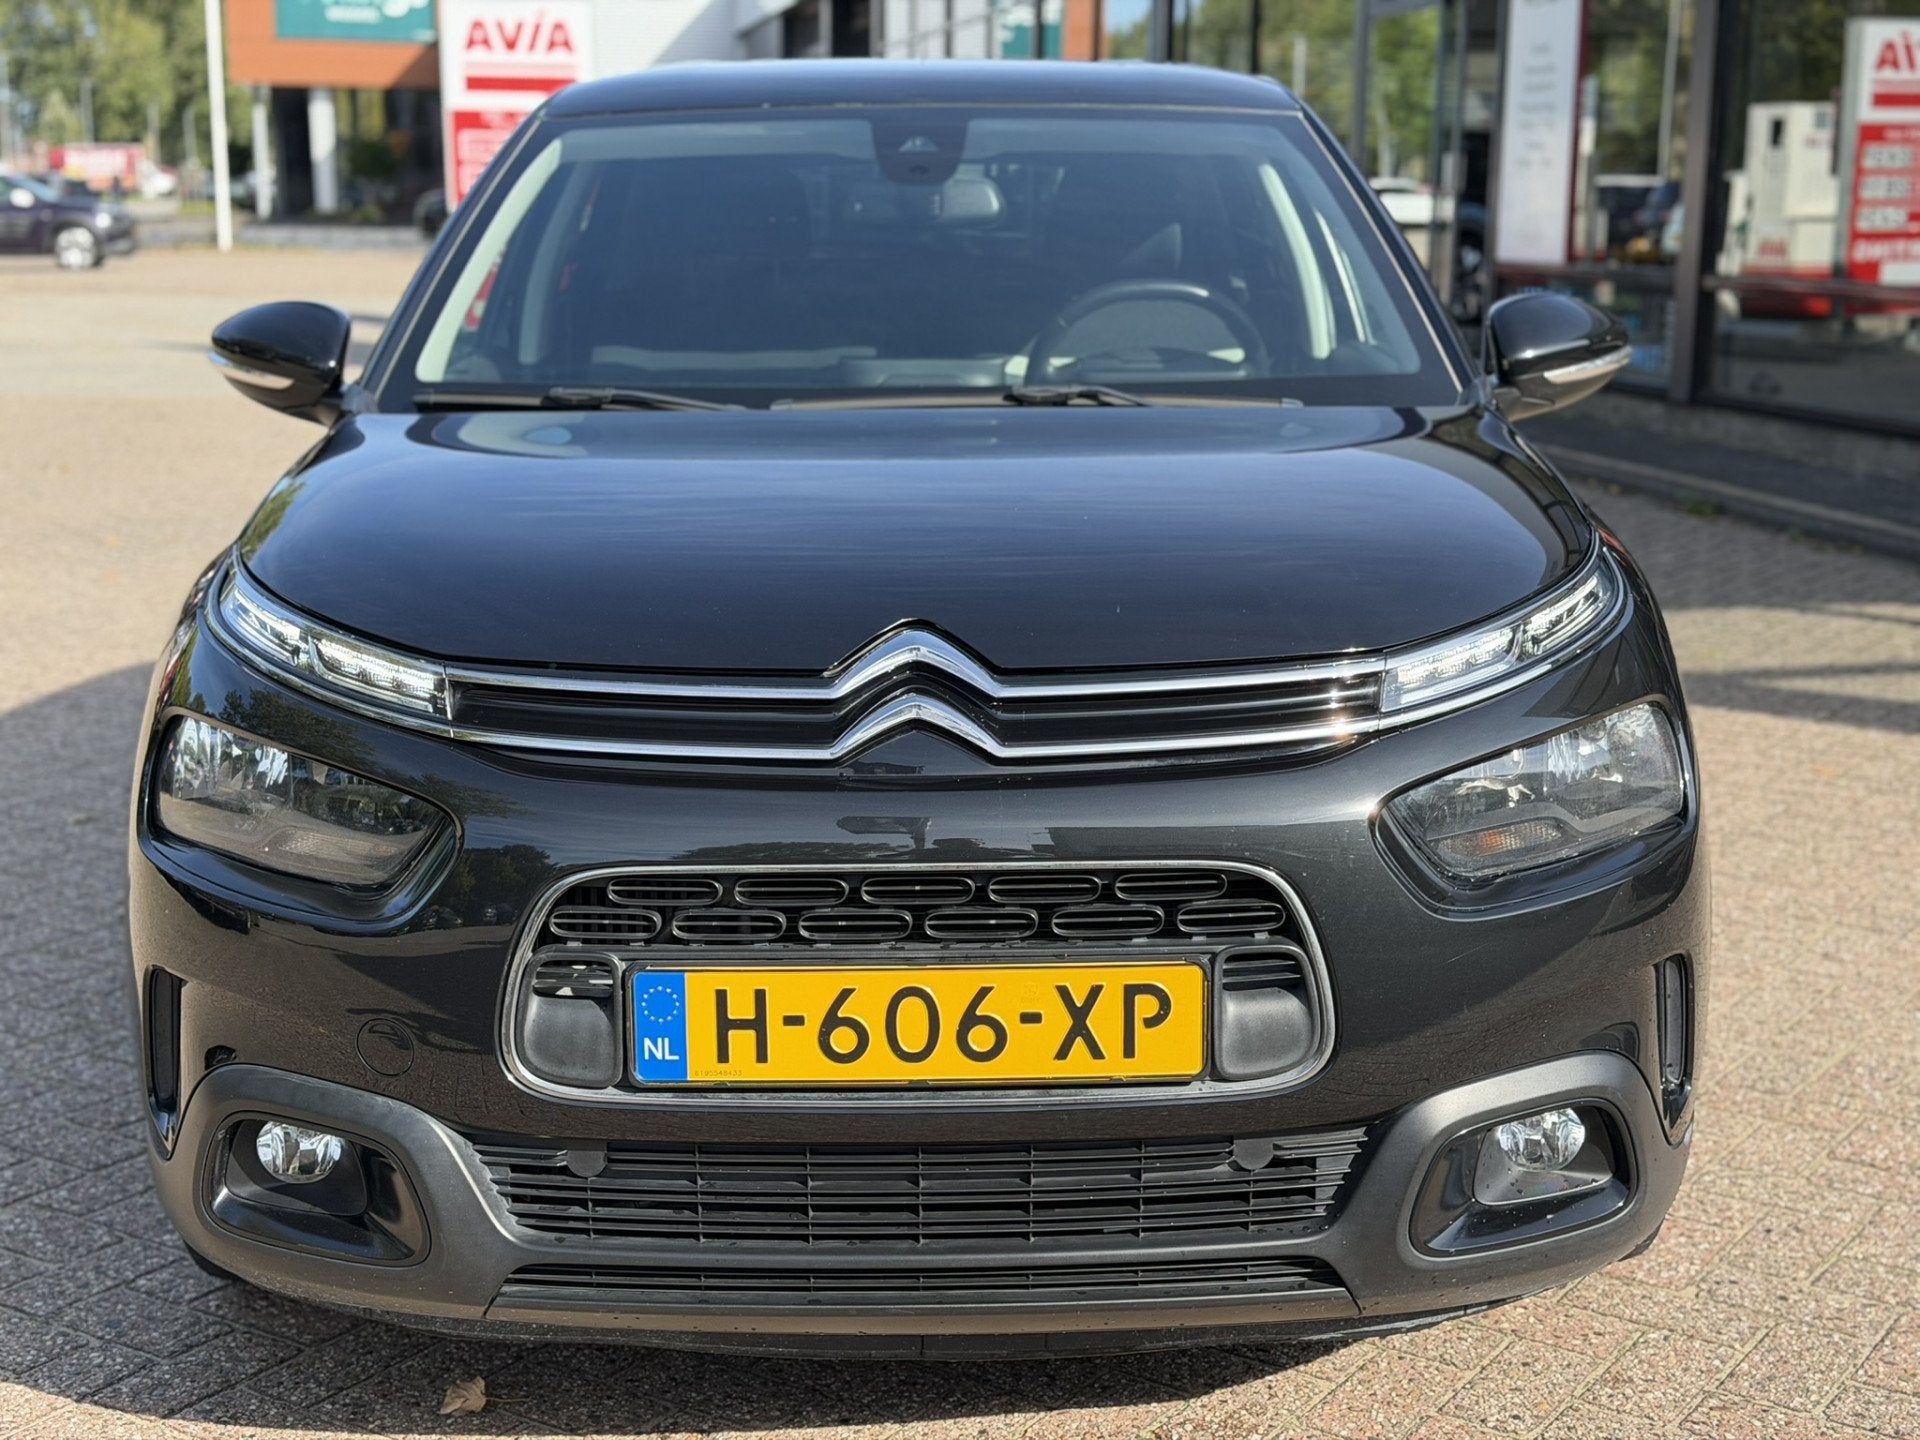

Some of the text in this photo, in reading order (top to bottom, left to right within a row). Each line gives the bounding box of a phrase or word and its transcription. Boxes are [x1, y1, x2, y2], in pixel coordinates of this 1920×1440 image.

[466, 9, 574, 52] AVIA
[715, 984, 1172, 1064] H-606-XP
[643, 1037, 680, 1061] NL
